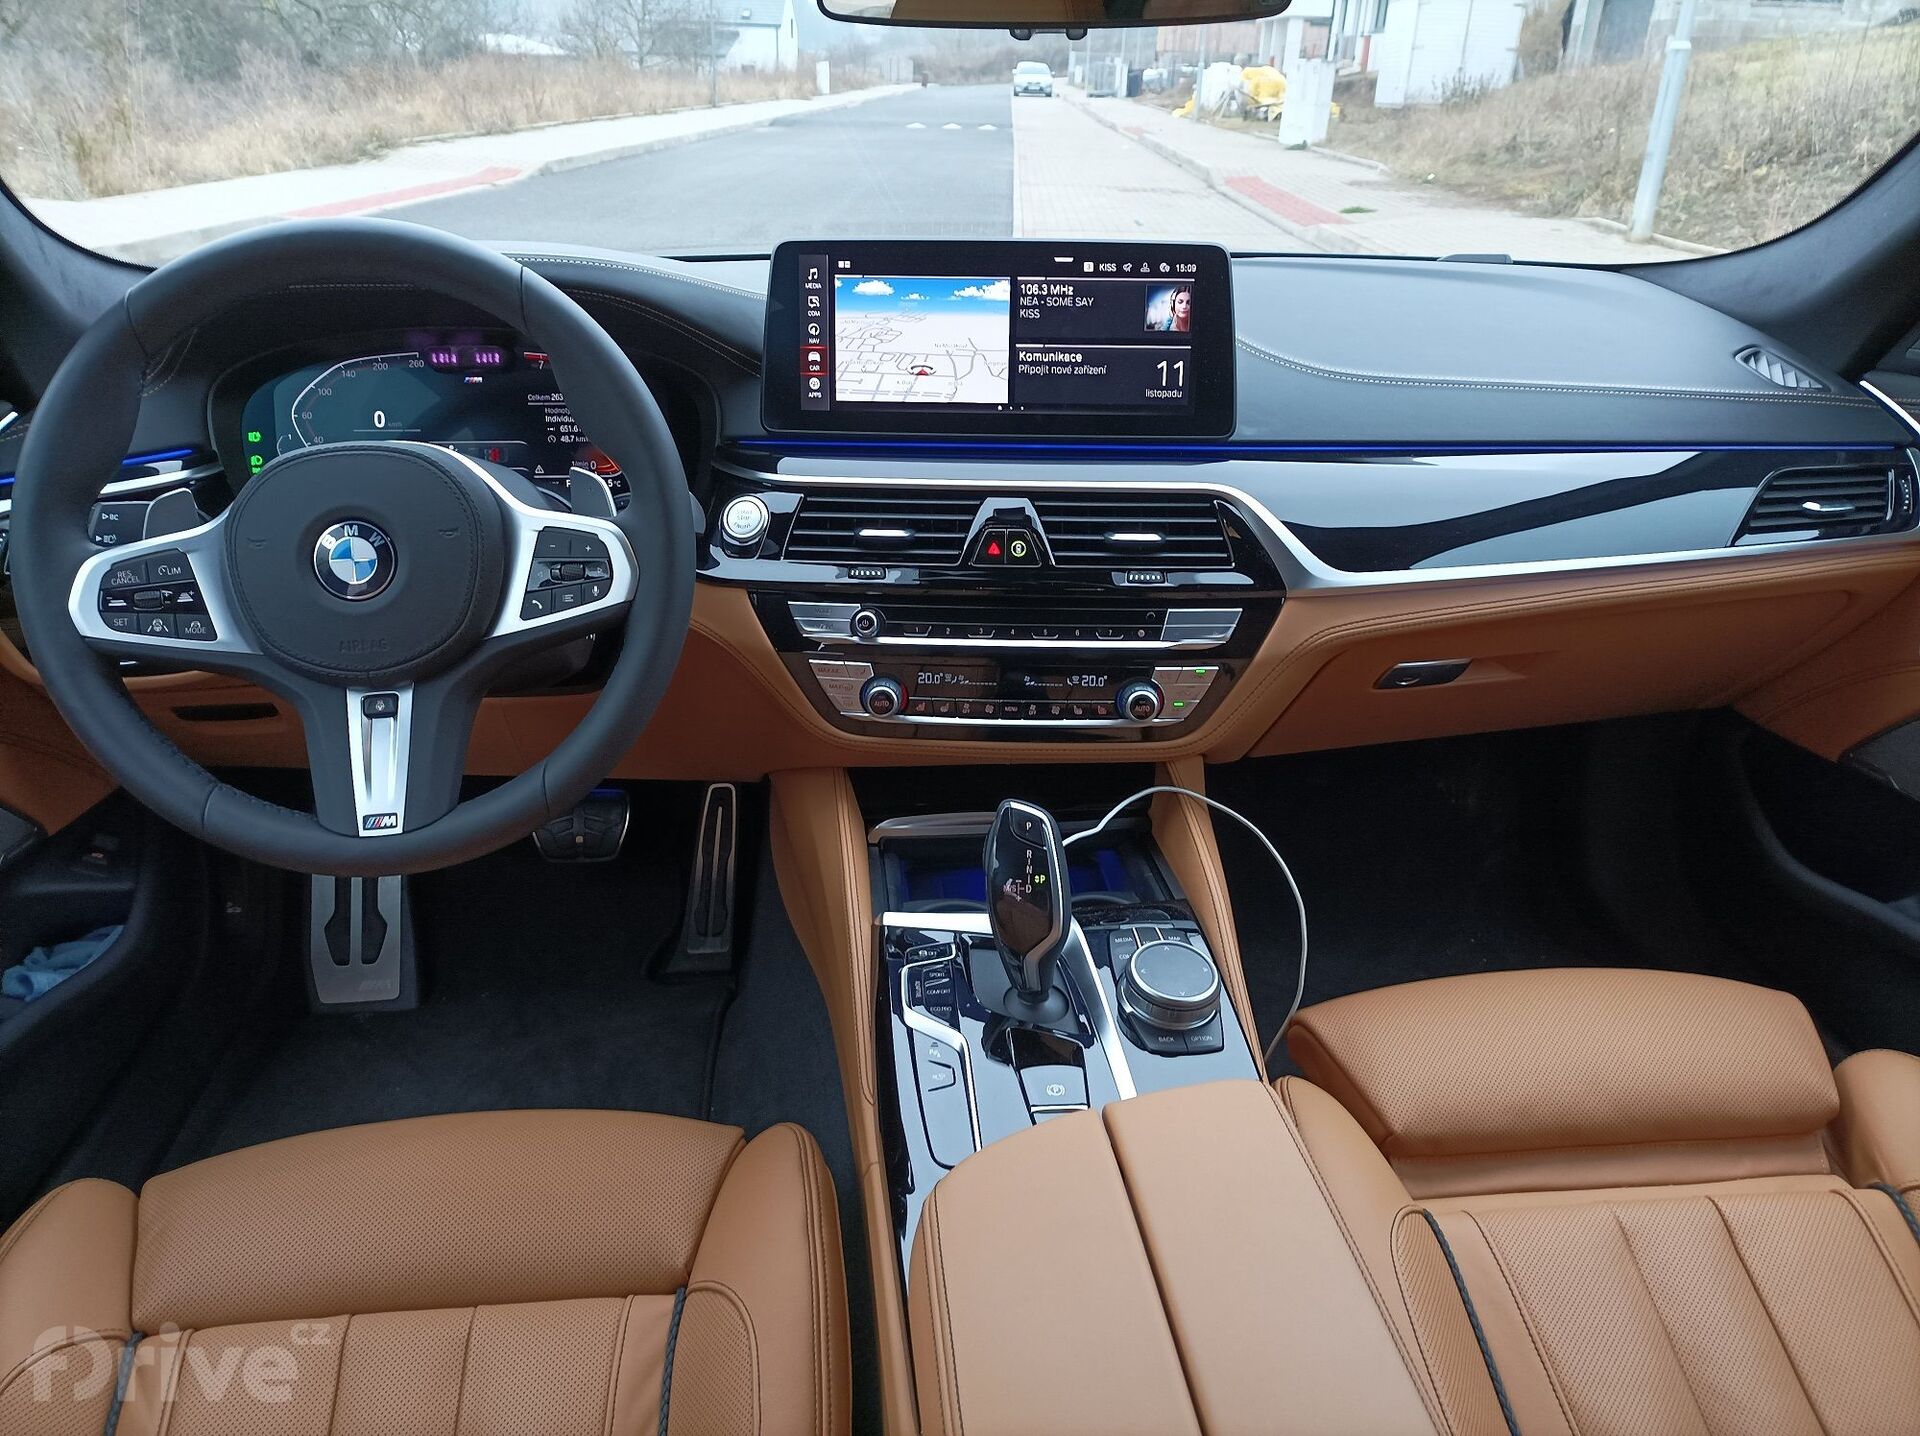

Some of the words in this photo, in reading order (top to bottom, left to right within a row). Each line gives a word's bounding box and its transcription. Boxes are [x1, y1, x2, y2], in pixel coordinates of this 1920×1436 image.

[1099, 263, 1117, 272] KISS
[1176, 264, 1197, 273] 15:09
[1020, 284, 1048, 295] 106.3
[1050, 285, 1074, 295] MHz
[1020, 297, 1039, 306] NEA
[1046, 297, 1073, 307] SOME
[1075, 298, 1094, 307] SAY
[1019, 309, 1040, 318] KISS
[1018, 351, 1083, 363] Komunikace
[373, 363, 388, 371] 200
[408, 360, 425, 368] 260
[538, 361, 544, 370] 7
[341, 370, 356, 378] 140
[1018, 364, 1050, 376] Připojit
[1051, 365, 1072, 374] nové
[1074, 364, 1107, 375] zařízení
[1157, 360, 1185, 387] 11
[317, 387, 332, 396] 100
[1145, 388, 1183, 399] listopadu
[527, 393, 550, 401] Celkem
[551, 393, 564, 401] 263
[301, 411, 313, 420] 60
[373, 410, 386, 428] 0
[560, 425, 579, 433] 651.6
[313, 436, 324, 444] 40
[590, 460, 597, 470] 0
[321, 524, 385, 550] BMW
[167, 566, 182, 575] LIM
[111, 576, 140, 586] CANCEL
[113, 618, 129, 626] SET
[185, 626, 207, 634] MODE
[874, 700, 889, 708] AUTO
[1026, 822, 1032, 830] P
[1026, 849, 1032, 858] R
[1026, 865, 1032, 874] N
[1040, 875, 1046, 883] P
[1026, 884, 1032, 893] D
